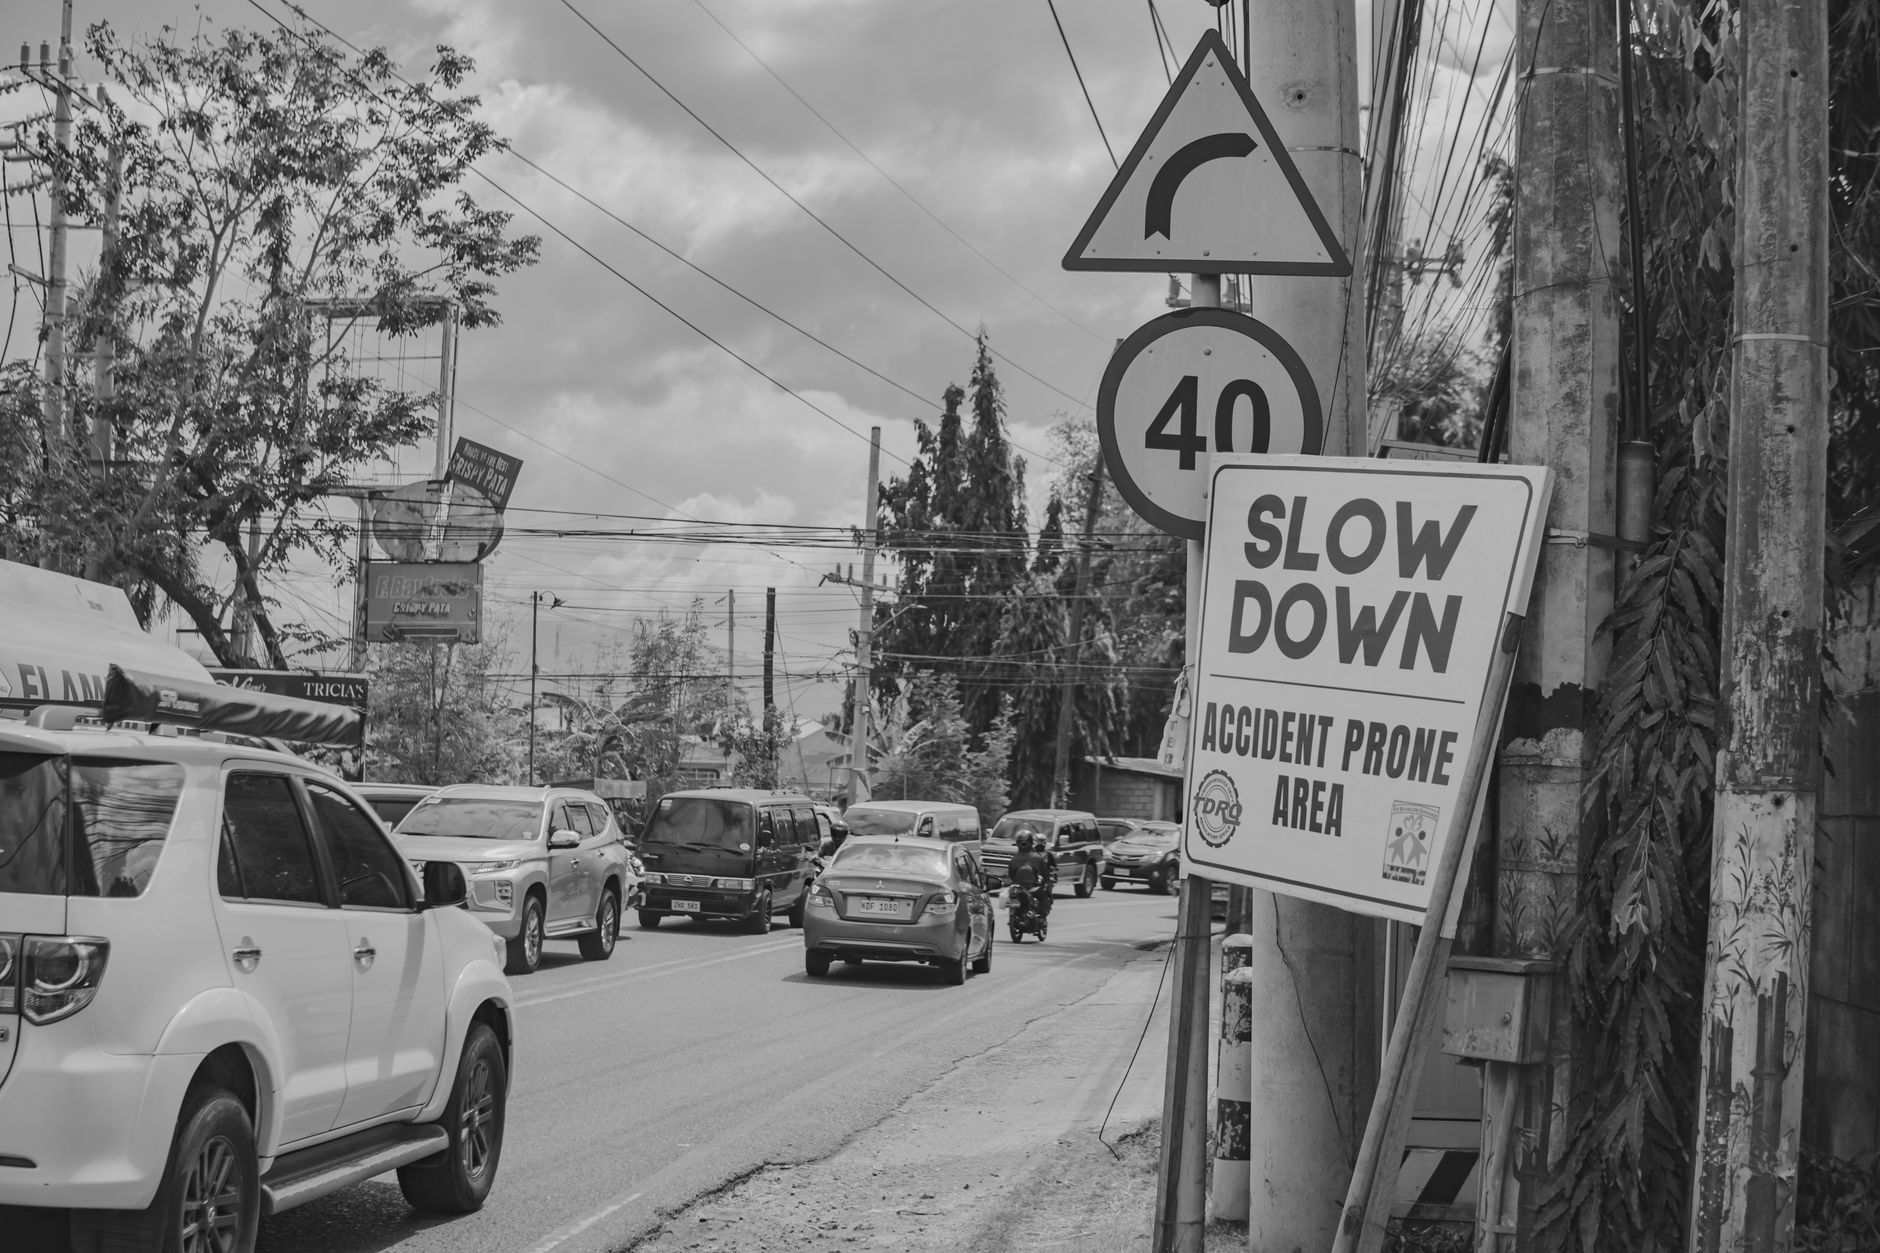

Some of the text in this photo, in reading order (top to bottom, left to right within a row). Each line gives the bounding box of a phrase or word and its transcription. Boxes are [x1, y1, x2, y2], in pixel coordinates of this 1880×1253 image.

[1144, 375, 1271, 471] 40
[449, 452, 509, 496] CRISPY PATA
[495, 456, 510, 473] BEST
[1243, 493, 1478, 581] SLOW
[393, 602, 451, 614] CRISPY PATA
[1227, 579, 1463, 674] DOWN
[303, 681, 365, 699] TRICIA'S
[1201, 701, 1459, 787] ACCIDENT PRONE
[1193, 796, 1243, 826] TDRO
[1271, 775, 1345, 838] AREA
